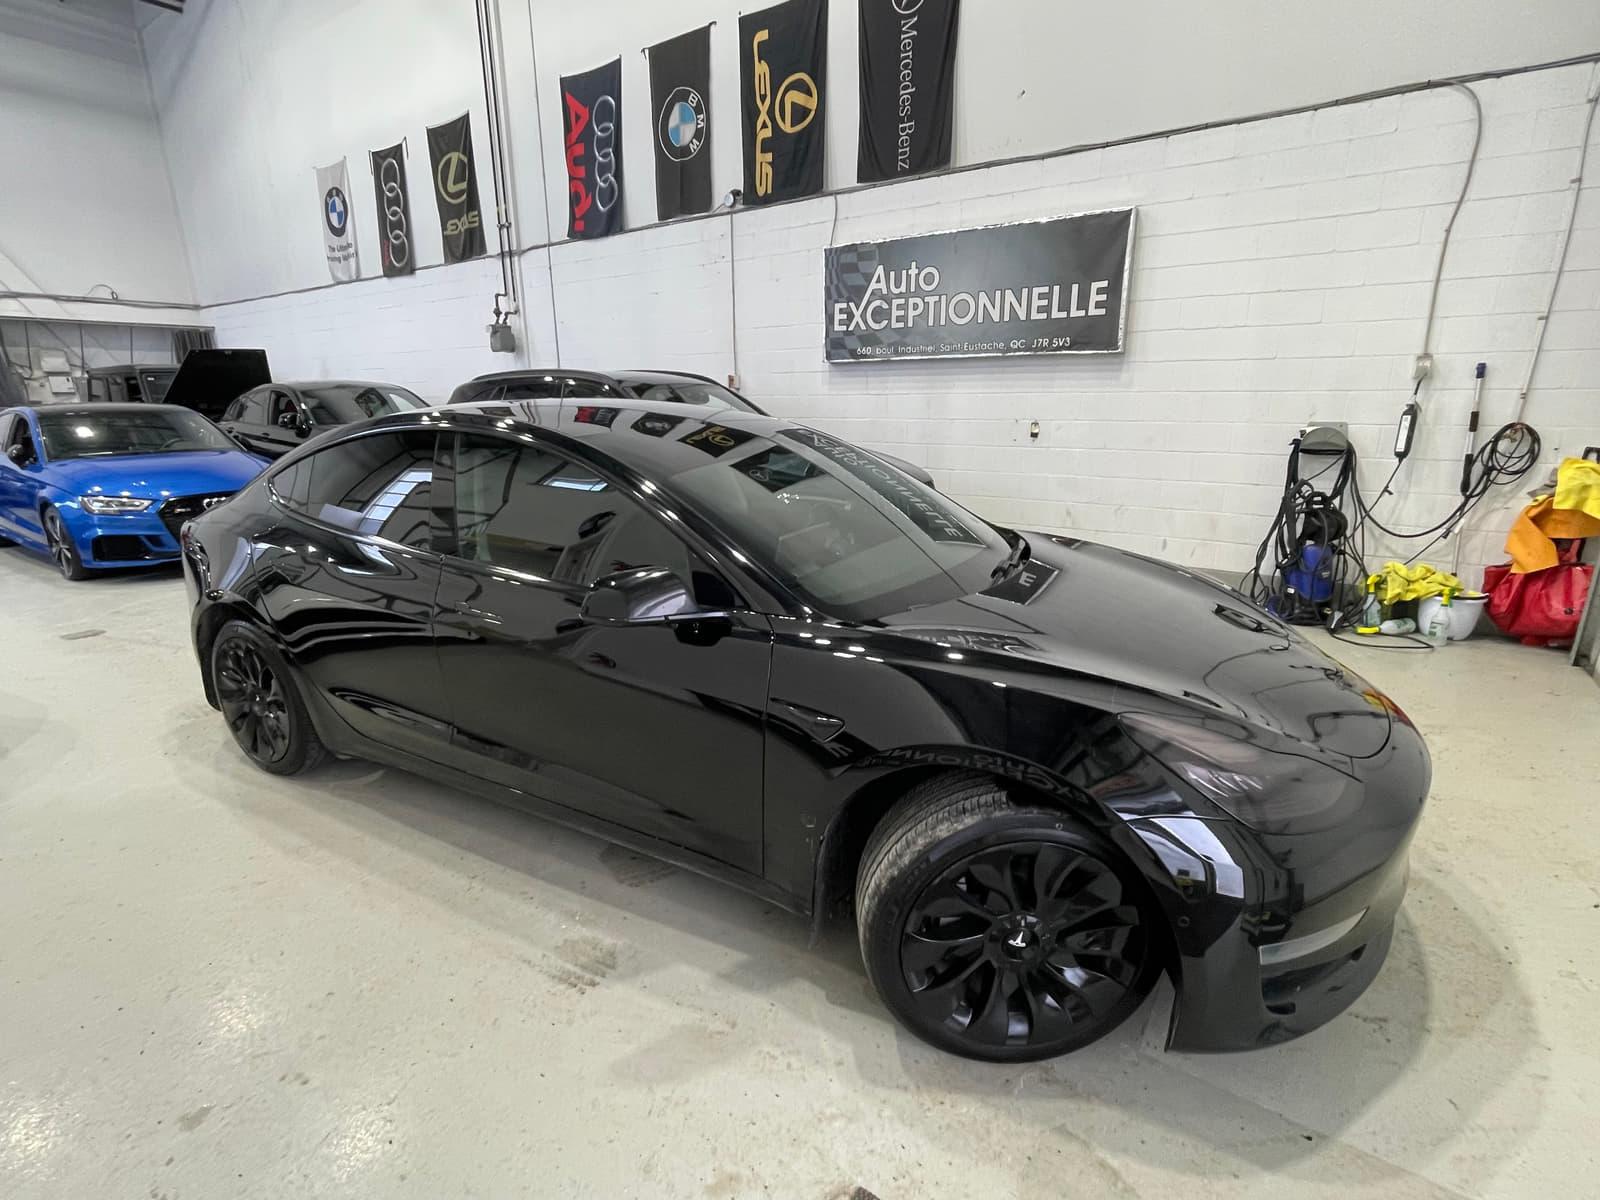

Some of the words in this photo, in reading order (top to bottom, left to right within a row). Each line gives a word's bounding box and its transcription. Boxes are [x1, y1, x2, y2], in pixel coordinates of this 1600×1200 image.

[752, 28, 774, 198] LEXUS
[897, 15, 919, 172] Mercedes-Benz
[687, 92, 704, 153] BMW
[443, 210, 480, 236] EXS
[833, 279, 1110, 332] EXCEPTIONNELLE
[865, 260, 941, 299] Auto
[1010, 339, 1027, 350] QC
[1031, 338, 1050, 349] J7R
[1052, 336, 1071, 348] 5V3
